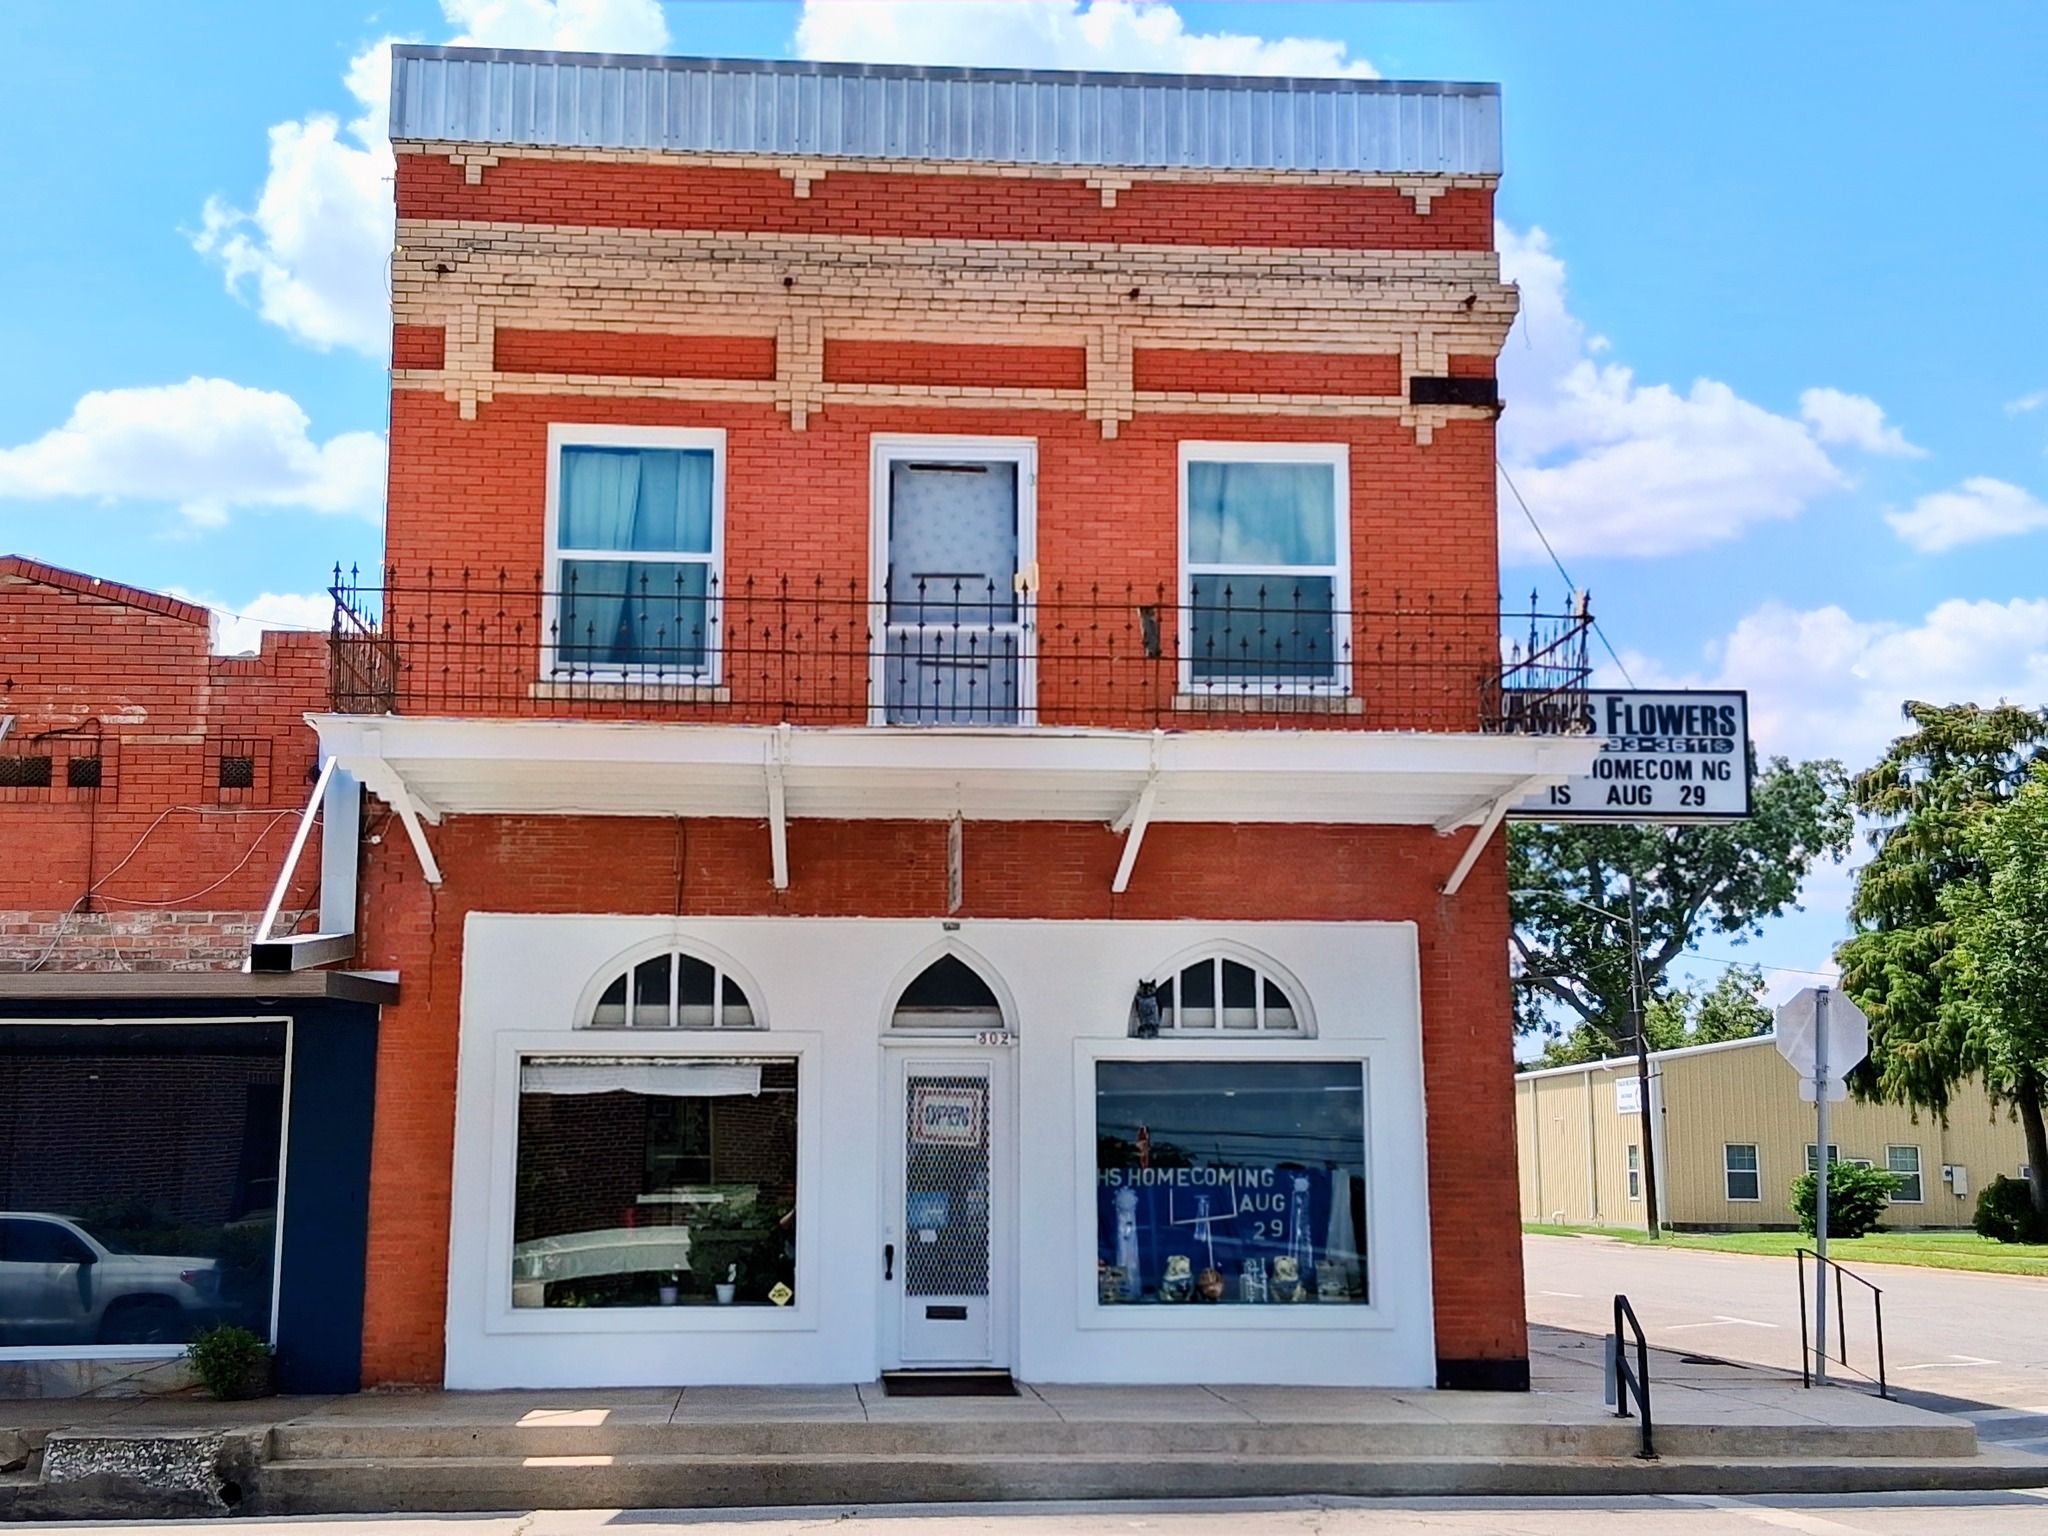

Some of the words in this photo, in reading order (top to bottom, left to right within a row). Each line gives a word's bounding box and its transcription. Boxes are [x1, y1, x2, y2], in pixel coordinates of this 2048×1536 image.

[1606, 696, 1737, 737] FLOWERS
[1601, 737, 1713, 752] 93-3611
[1606, 785, 1653, 806] AUG
[1680, 785, 1706, 806] 29
[979, 1031, 1009, 1045] 302
[1128, 1167, 1275, 1188] HOMECOMING
[1239, 1194, 1286, 1213] AUG
